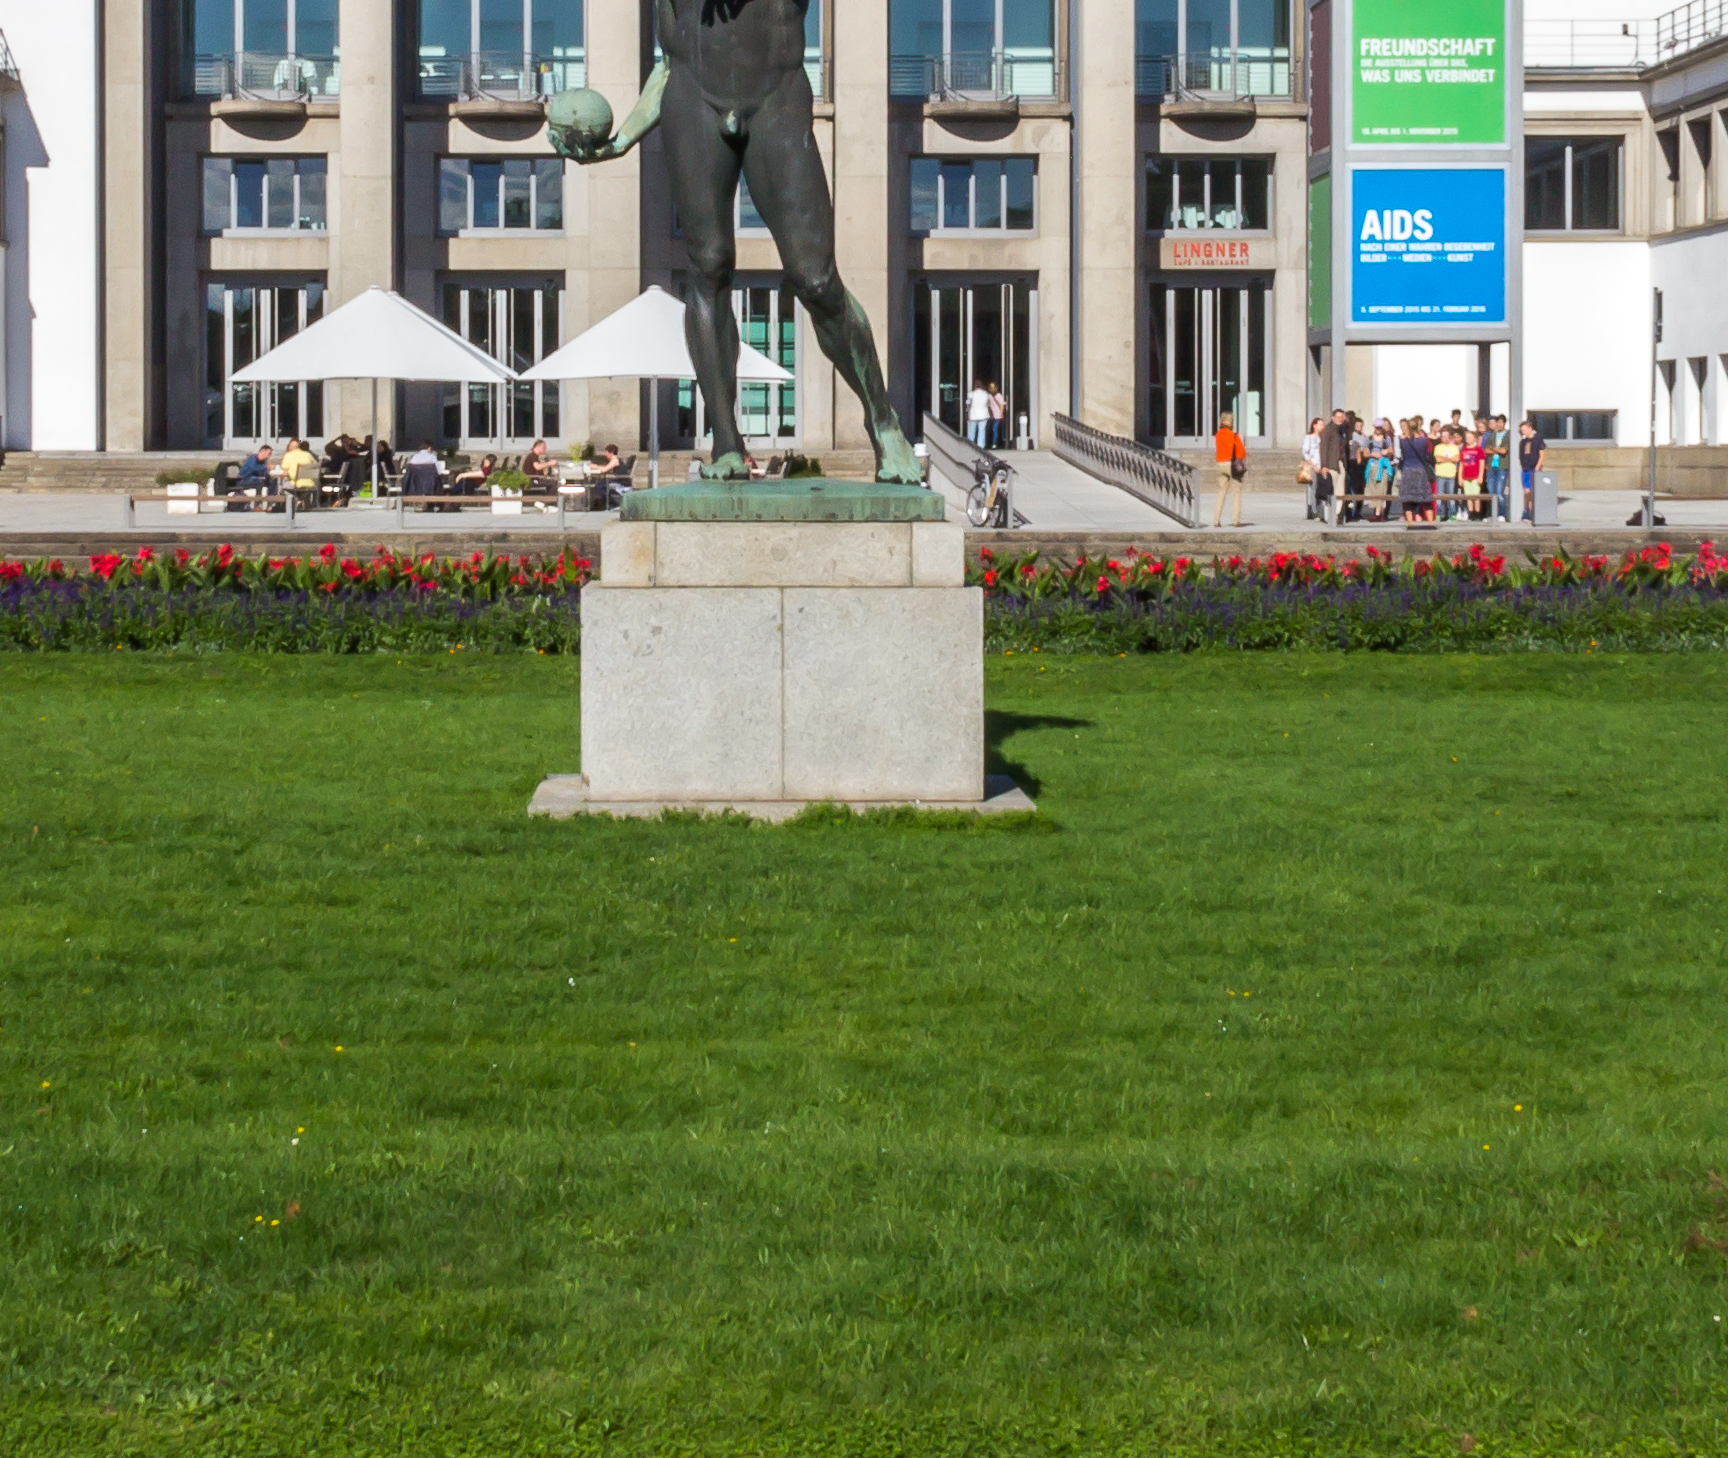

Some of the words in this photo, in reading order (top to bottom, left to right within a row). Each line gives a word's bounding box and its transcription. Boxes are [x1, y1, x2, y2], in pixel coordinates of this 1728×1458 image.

[1360, 38, 1495, 57] FREUNDSCHAFT
[1360, 69, 1391, 83] WAS
[1394, 69, 1422, 83] UNS
[1425, 69, 1495, 83] VERBINDET
[1360, 209, 1434, 241] AIDS
[1173, 242, 1249, 258] LINGNER
